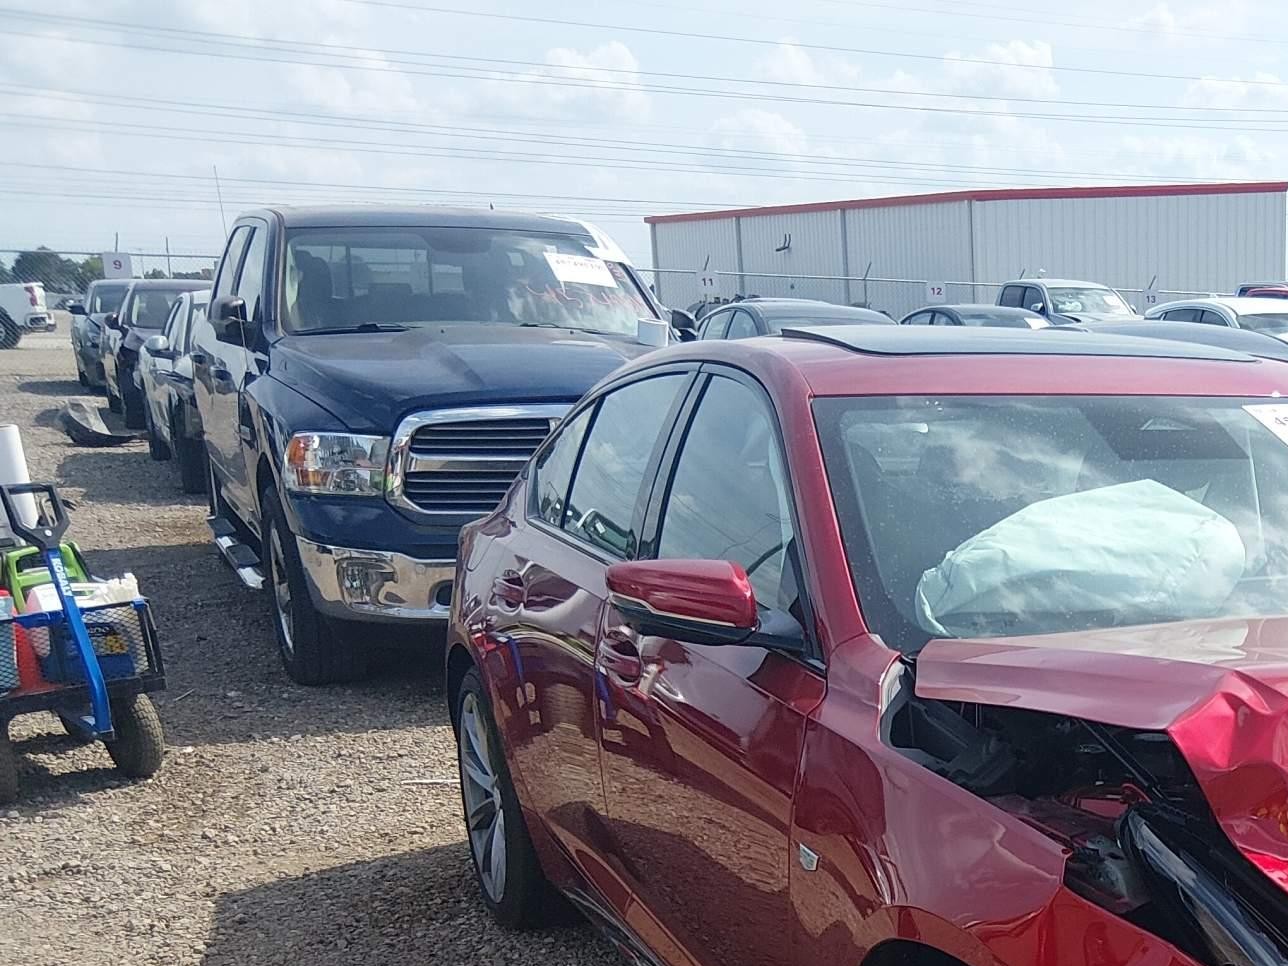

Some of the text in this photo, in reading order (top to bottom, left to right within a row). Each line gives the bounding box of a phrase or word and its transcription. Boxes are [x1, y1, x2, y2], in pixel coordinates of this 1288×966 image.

[112, 259, 122, 270] 9
[702, 277, 713, 287] 11
[930, 287, 943, 296] 12
[1146, 295, 1156, 304] 13
